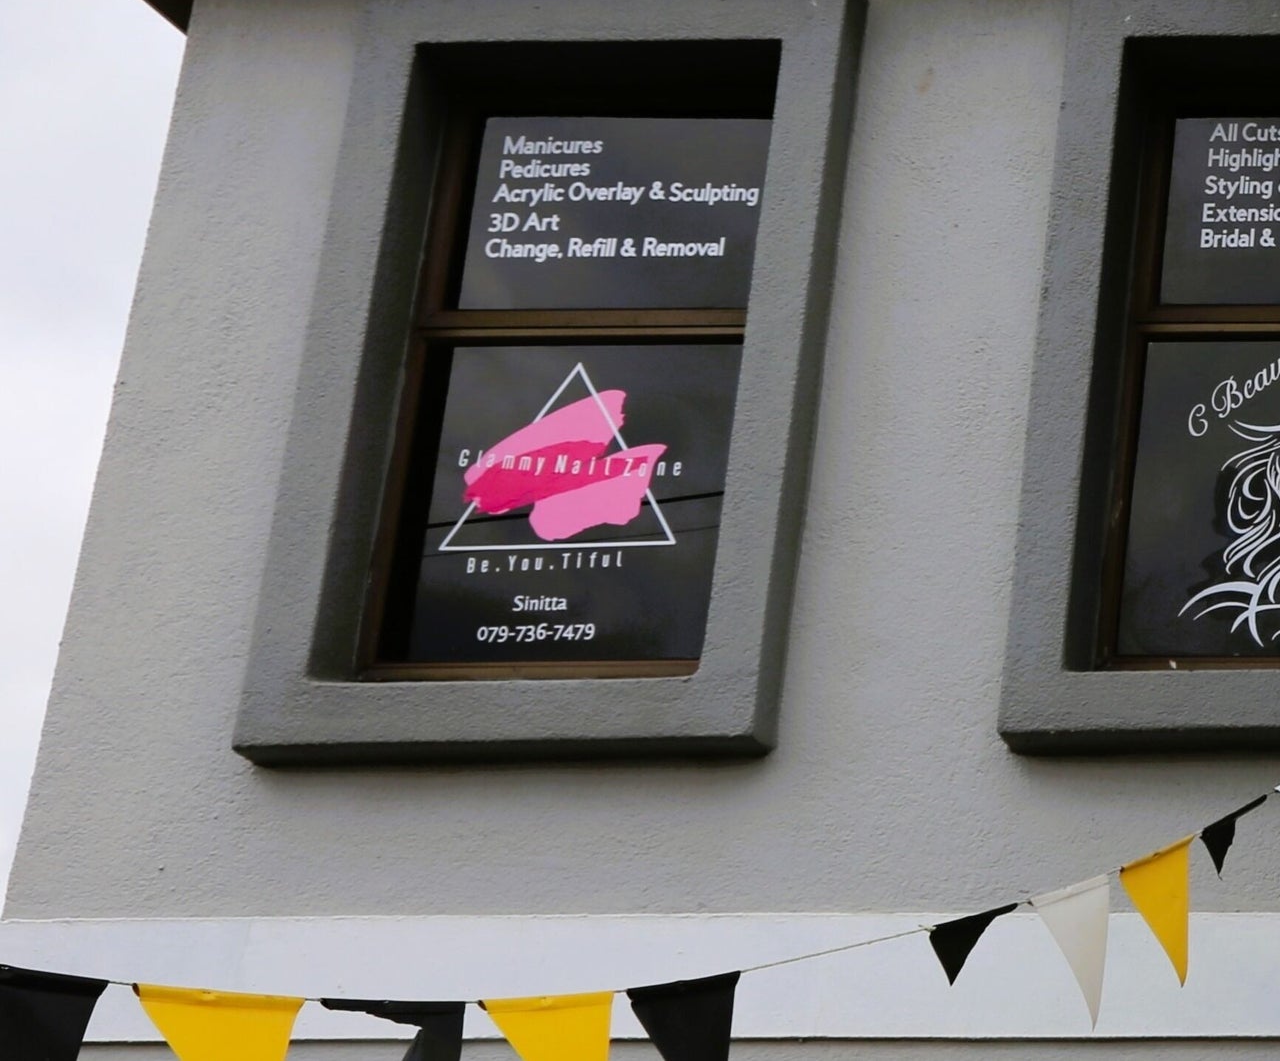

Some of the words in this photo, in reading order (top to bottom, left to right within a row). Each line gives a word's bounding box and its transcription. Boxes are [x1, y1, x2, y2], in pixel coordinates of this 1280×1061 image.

[1209, 123, 1238, 142] All
[503, 136, 603, 155] Manicures
[499, 160, 590, 179] Pedicures
[493, 183, 564, 207] Acrylic
[568, 182, 645, 205] Overlay
[649, 182, 666, 200] &
[668, 183, 759, 206] Sculpting
[1204, 175, 1273, 199] Styling
[488, 213, 520, 232] 3D
[522, 213, 560, 232] Art
[1200, 228, 1255, 248] Bridal
[1260, 228, 1276, 246] &
[485, 239, 563, 263] Change,
[567, 238, 616, 258] Refill
[620, 239, 637, 258] &
[642, 237, 725, 257] Removal
[458, 449, 546, 476] Glammy
[554, 454, 610, 475] Nail
[622, 459, 682, 478] Zone
[512, 595, 567, 612] Sinitta
[476, 623, 596, 643] 079-736-7479
